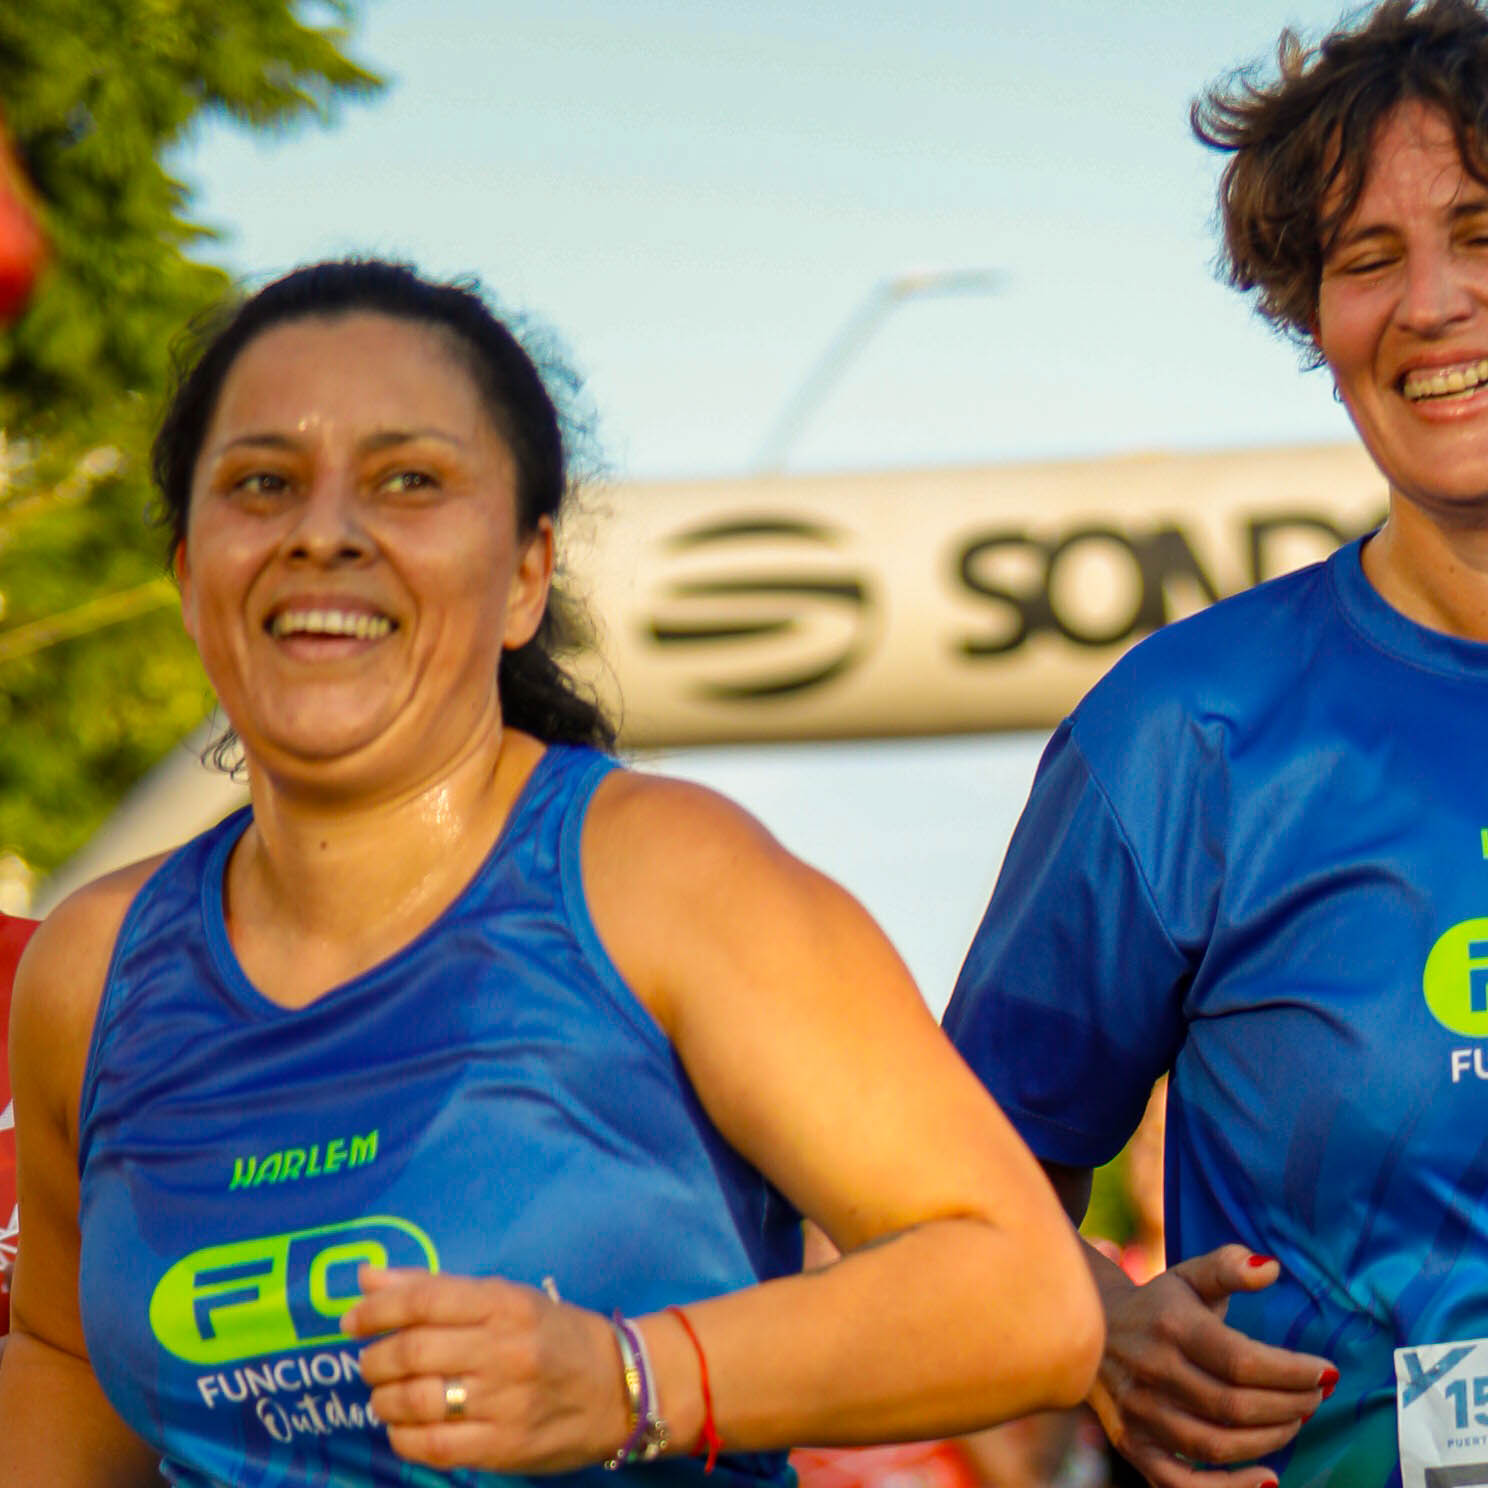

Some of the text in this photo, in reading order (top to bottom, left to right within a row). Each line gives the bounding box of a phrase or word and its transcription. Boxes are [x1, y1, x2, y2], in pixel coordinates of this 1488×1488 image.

[228, 1129, 380, 1191] HARLEM
[196, 1350, 365, 1409] FUNCION
[256, 1391, 380, 1444] Outdoo
